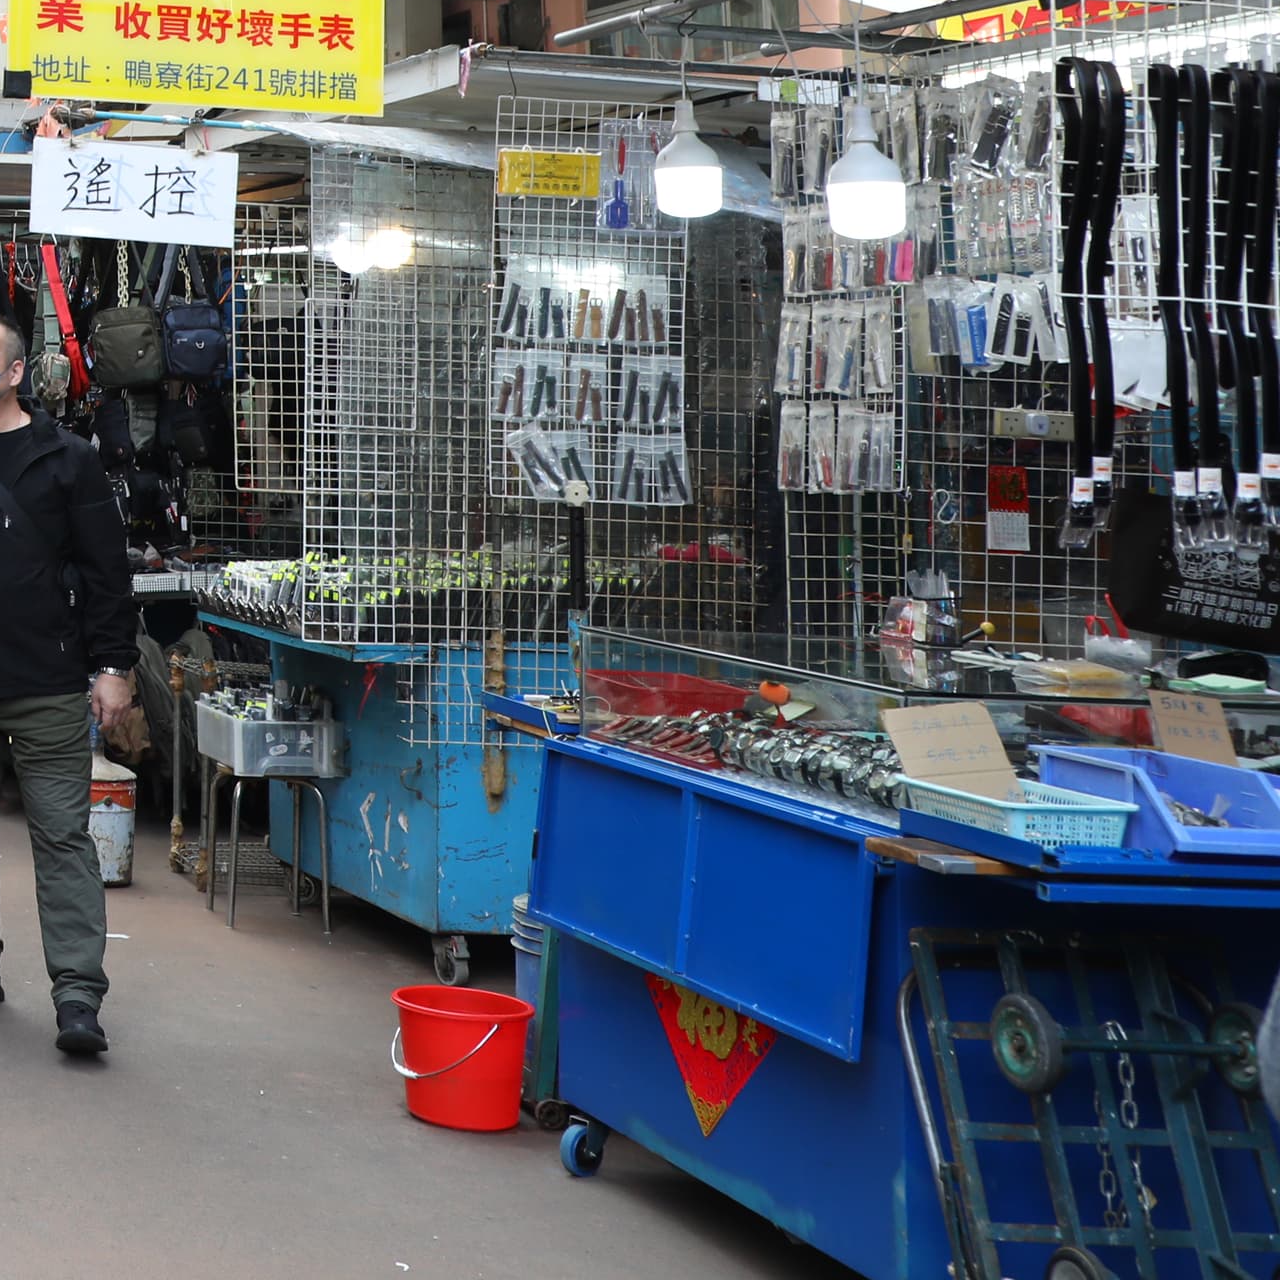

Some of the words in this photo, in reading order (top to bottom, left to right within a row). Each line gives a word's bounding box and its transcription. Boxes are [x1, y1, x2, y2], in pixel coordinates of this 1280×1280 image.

[113, 1, 356, 52] 收買好壞手表
[61, 156, 199, 219] 遙控
